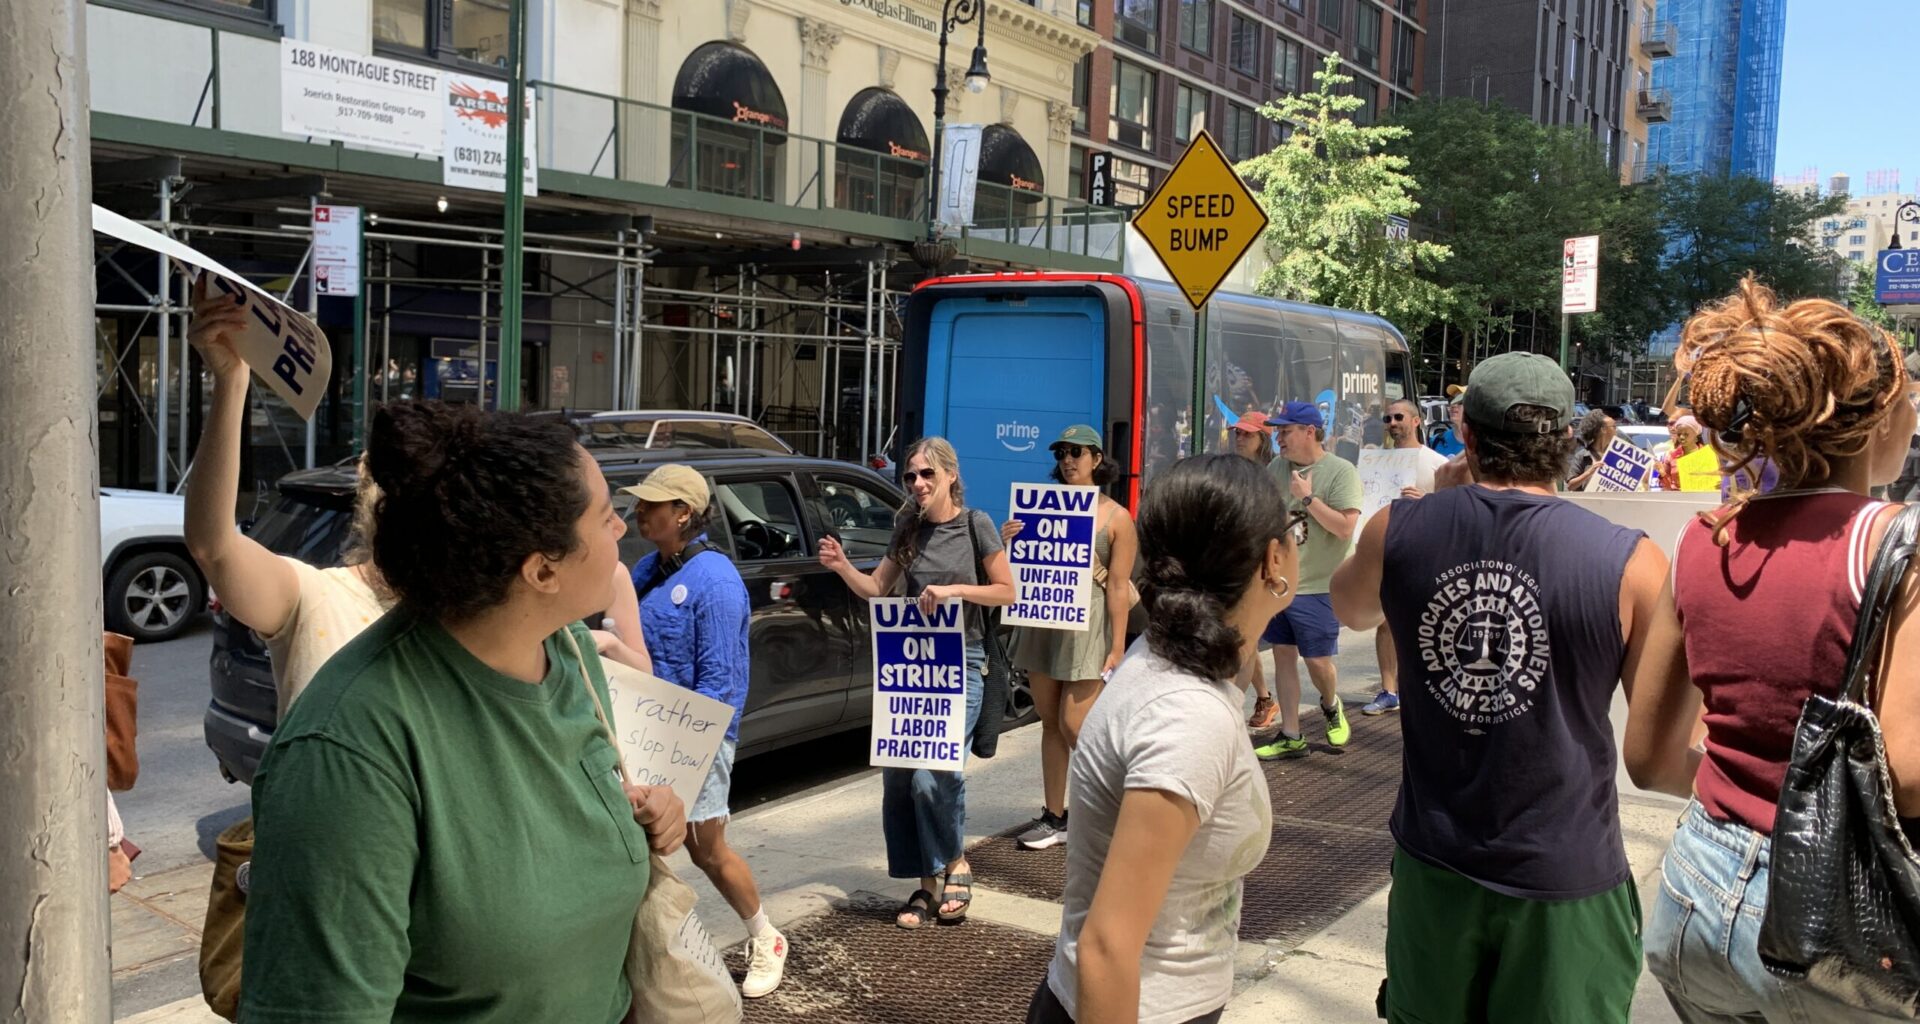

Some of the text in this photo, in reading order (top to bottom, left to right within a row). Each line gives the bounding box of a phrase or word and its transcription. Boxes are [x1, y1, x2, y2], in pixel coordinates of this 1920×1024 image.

[290, 48, 437, 91] 188 MONTAGUE STREET
[302, 87, 426, 119] Joerich Restoration Group Corp
[454, 97, 507, 113] ARSEN
[454, 146, 481, 165] (631)
[1167, 194, 1235, 219] SPEED
[1170, 228, 1228, 251] BUMP
[1342, 364, 1378, 401] prime
[996, 420, 1040, 439] prime
[1611, 439, 1651, 466] UAW
[1600, 464, 1639, 490] STRIKE
[1615, 459, 1633, 473] ON
[1015, 488, 1095, 512] UAW
[1037, 518, 1068, 539] ON
[1012, 539, 1090, 564] STRIKE
[1020, 567, 1079, 586] UNFAIR
[1435, 560, 1504, 585] ASSOCIATION
[1517, 569, 1541, 598] LEGAL
[1021, 586, 1074, 604] LABOR
[874, 603, 959, 628] UAW
[1007, 602, 1086, 623] PRACTICE
[1418, 573, 1549, 692] ADVOCATES AND ATTORNEYS
[902, 637, 936, 660] ON
[880, 663, 961, 689] STRIKE
[1428, 685, 1467, 721] WORKING
[1470, 714, 1491, 724] FOR
[1439, 676, 1475, 710] UAW
[635, 697, 718, 733] rather
[889, 697, 952, 716] UNFAIR
[891, 718, 947, 738] LABOR
[624, 727, 665, 761] slop
[670, 740, 709, 771] bowl
[876, 738, 960, 761] PRACTICE
